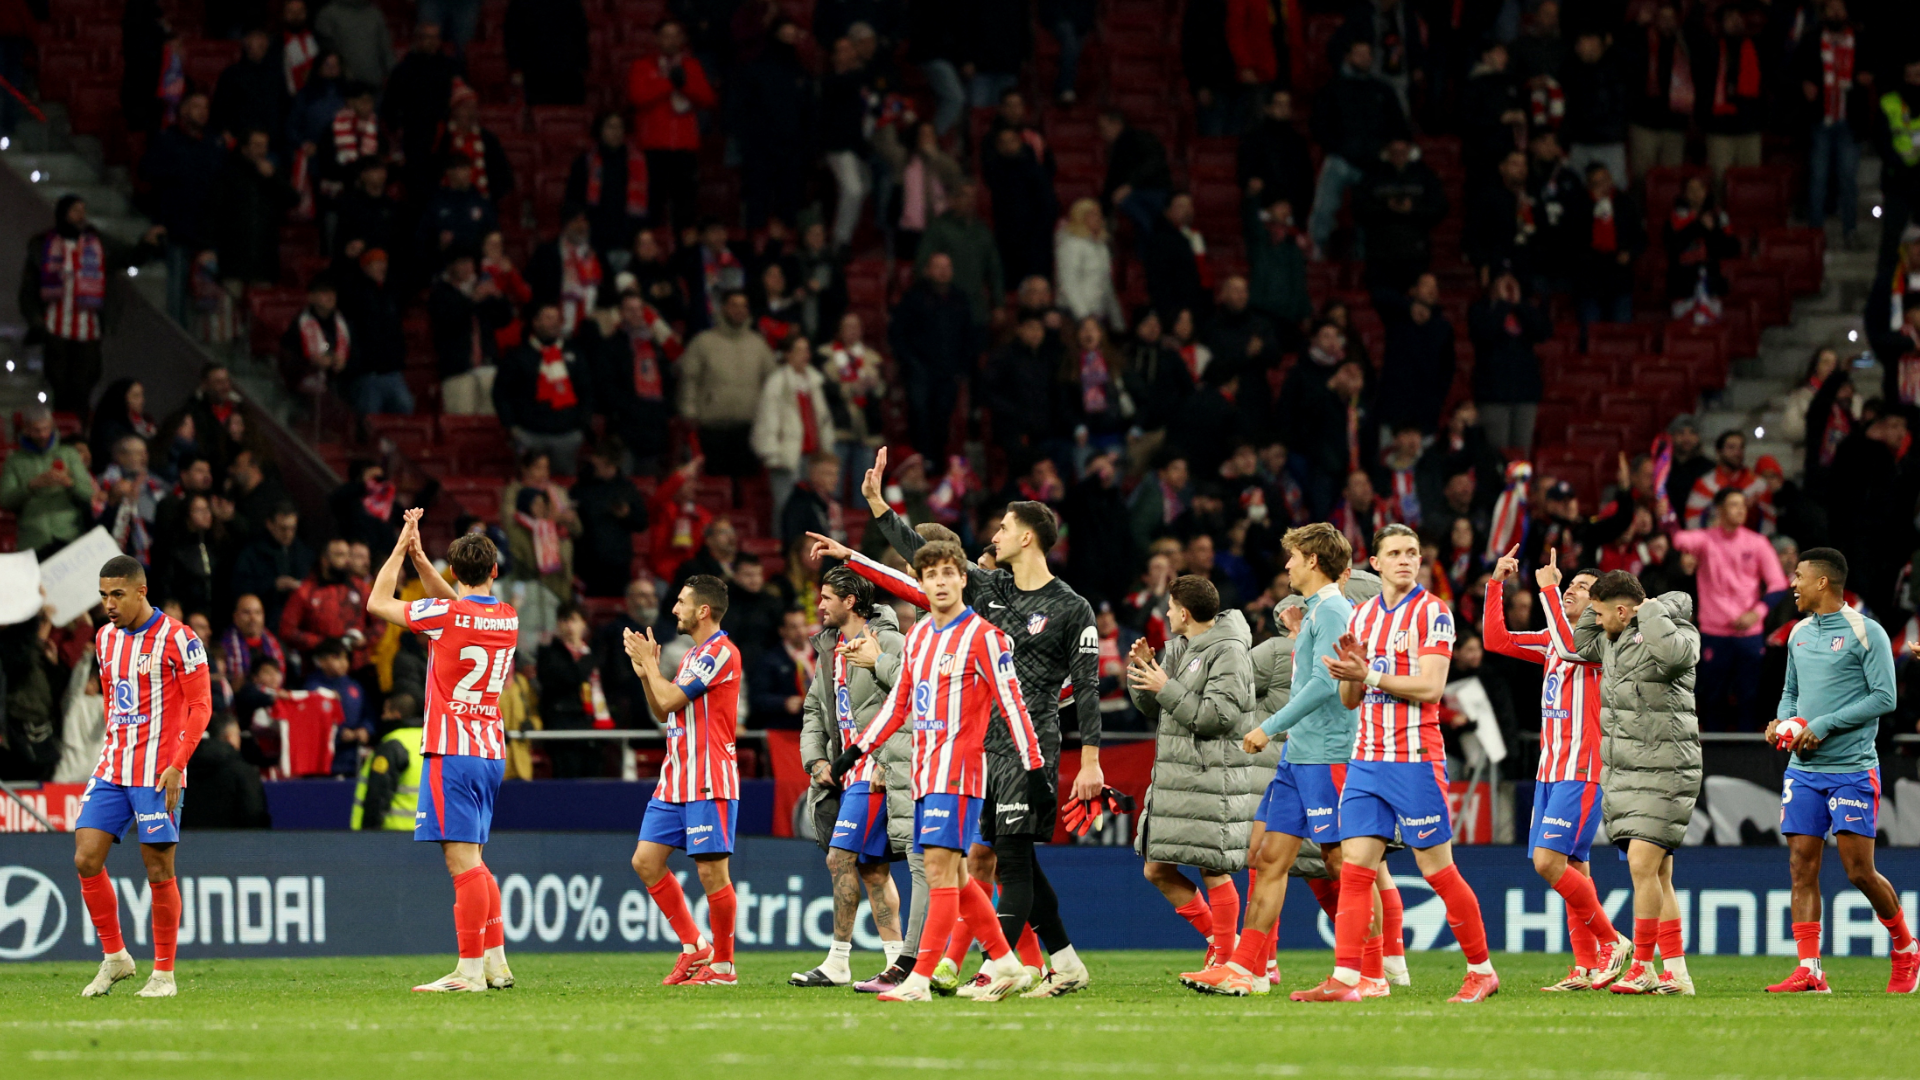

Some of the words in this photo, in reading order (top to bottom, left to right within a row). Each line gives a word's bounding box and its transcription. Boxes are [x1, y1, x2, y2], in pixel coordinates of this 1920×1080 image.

[455, 614, 471, 629] LE
[452, 645, 516, 704] 24
[131, 715, 147, 723] AIR
[927, 720, 944, 730] AIR
[1783, 778, 1794, 804] 3
[1838, 797, 1869, 810] ComAve
[1406, 814, 1441, 827] ComAve
[687, 825, 713, 835] ComAve
[494, 873, 609, 942] 00%
